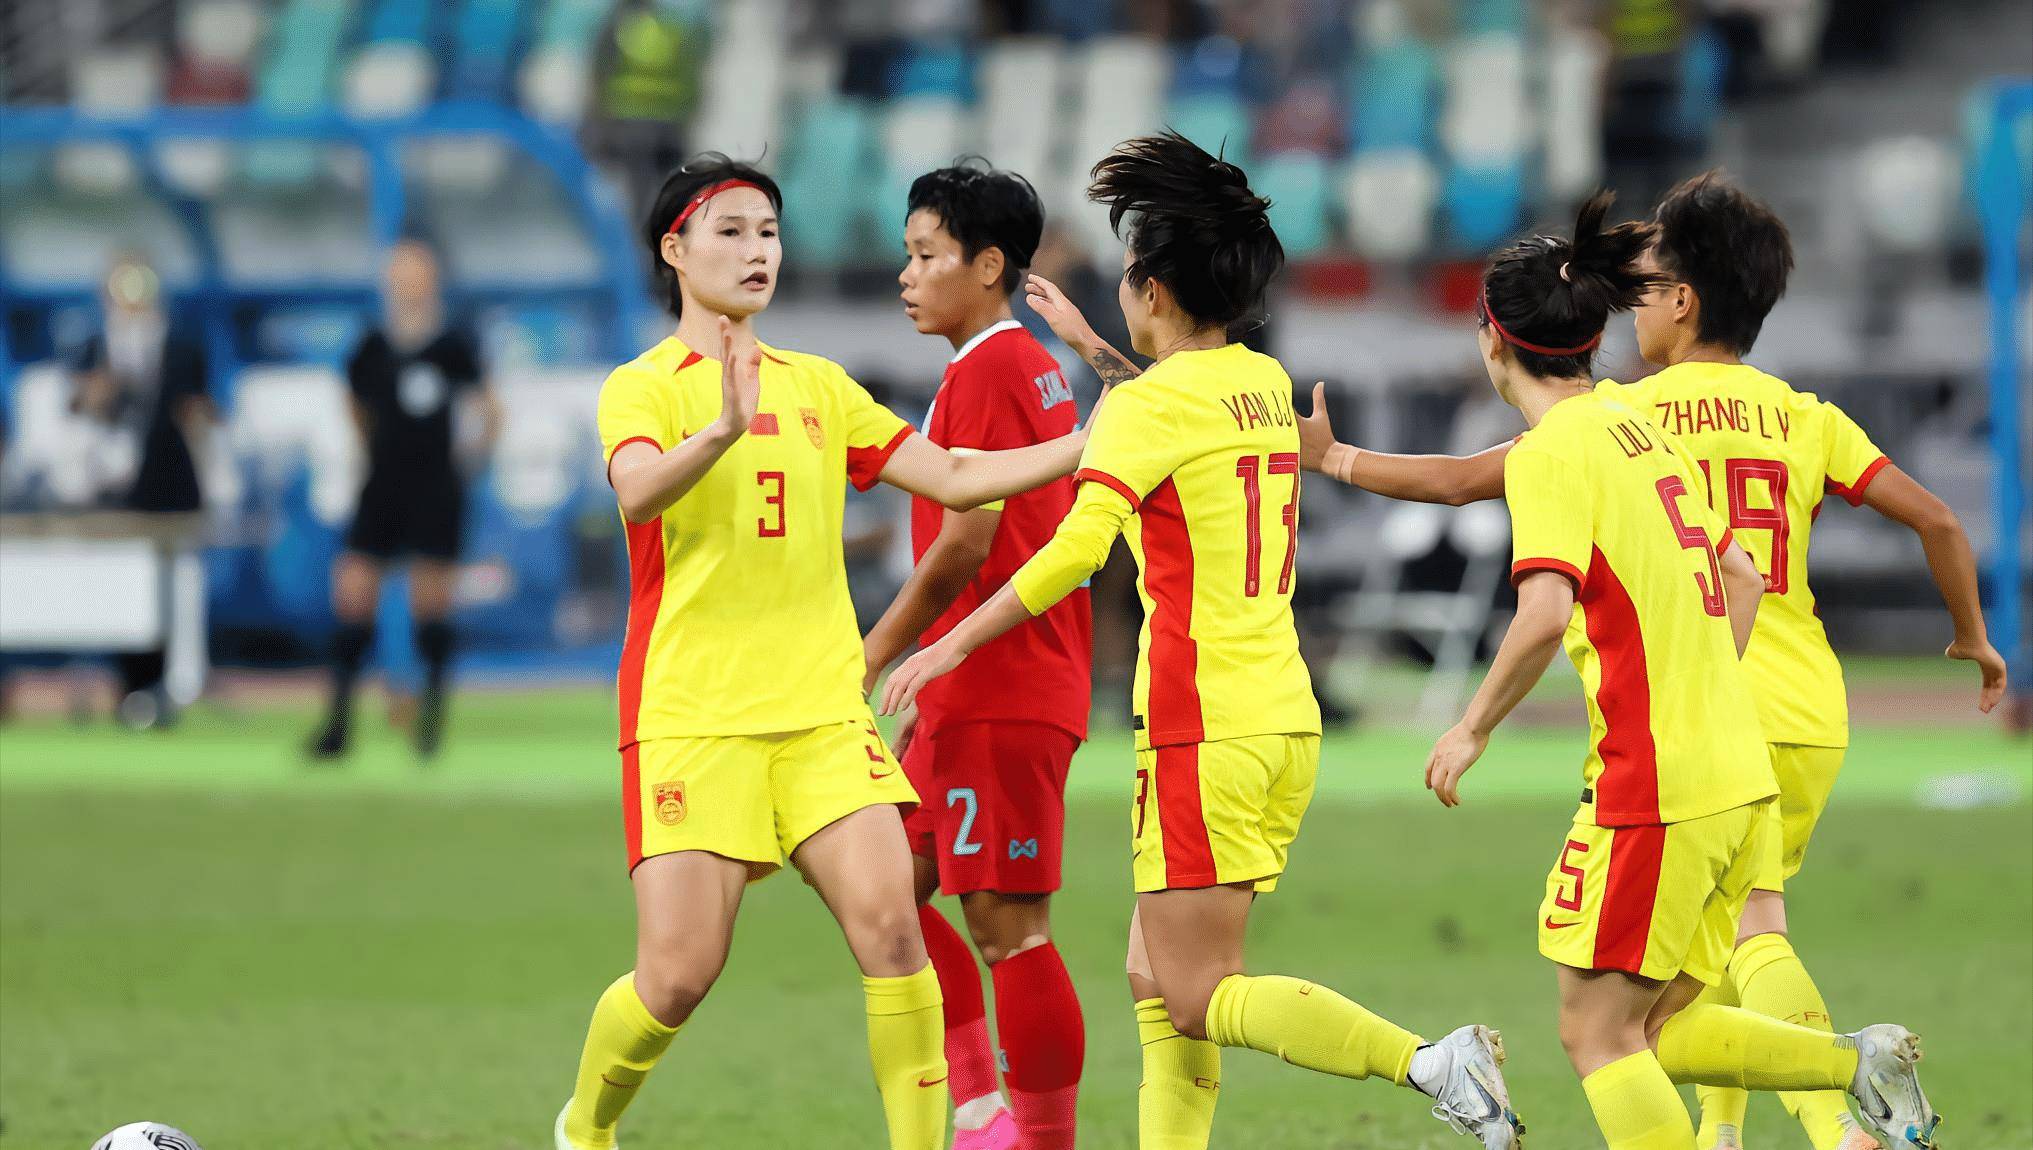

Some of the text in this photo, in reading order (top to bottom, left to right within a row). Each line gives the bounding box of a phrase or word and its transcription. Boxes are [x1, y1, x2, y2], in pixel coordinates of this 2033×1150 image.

[1220, 392, 1273, 432] YAN
[1607, 419, 1653, 458] LIU
[1656, 397, 1749, 435] ZHANG
[757, 471, 786, 537] 3
[1655, 475, 1727, 617] 5
[946, 787, 983, 856] 2
[1554, 838, 1590, 912] 5
